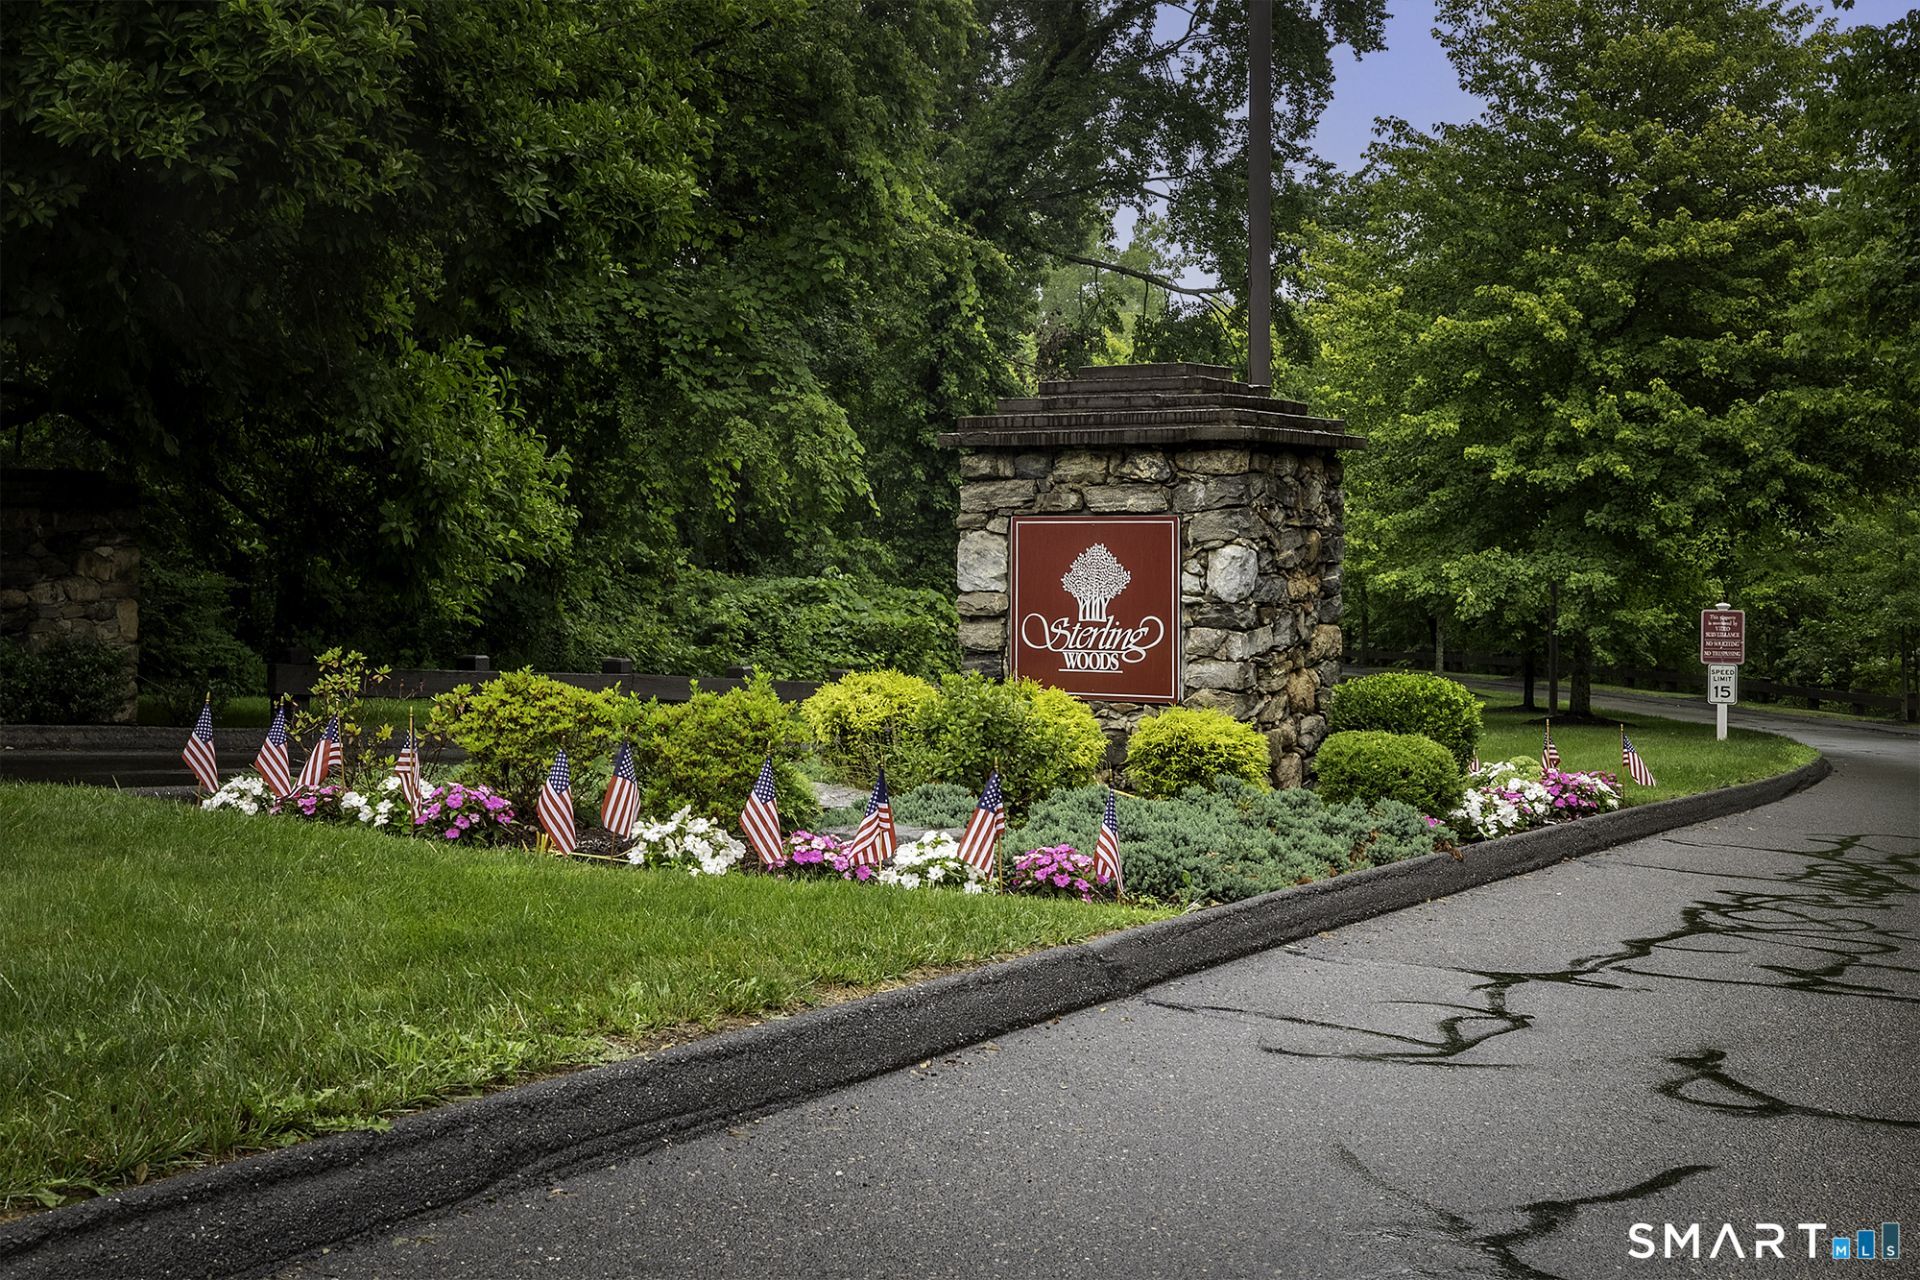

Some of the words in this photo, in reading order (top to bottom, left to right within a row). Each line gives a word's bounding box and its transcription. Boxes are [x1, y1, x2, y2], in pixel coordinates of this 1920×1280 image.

[1022, 613, 1164, 663] Sterling
[1063, 652, 1120, 671] WOODS
[1713, 685, 1731, 699] 15
